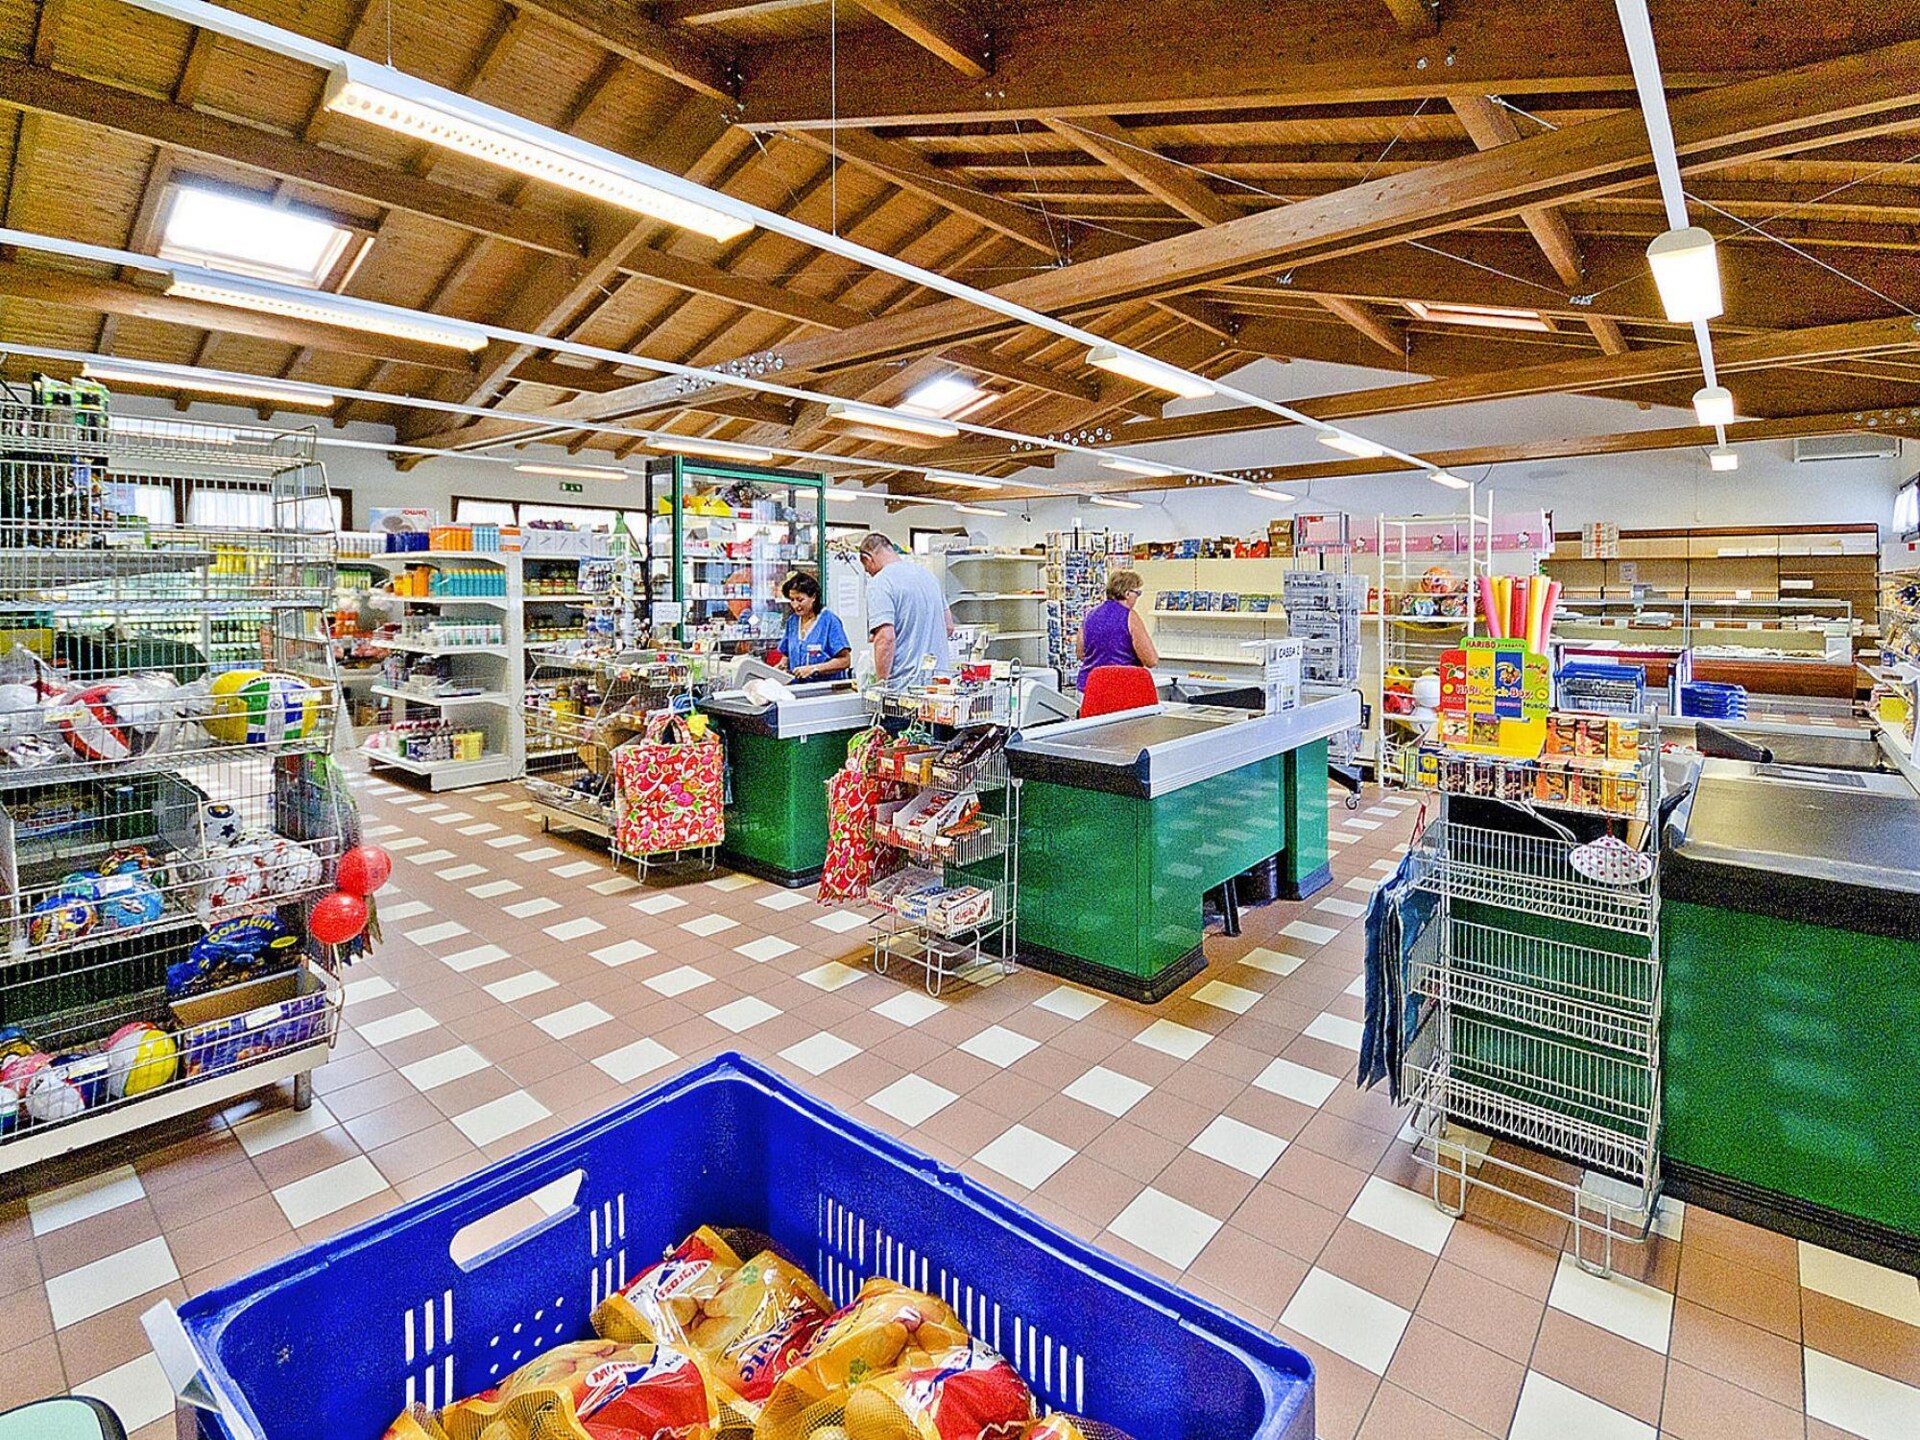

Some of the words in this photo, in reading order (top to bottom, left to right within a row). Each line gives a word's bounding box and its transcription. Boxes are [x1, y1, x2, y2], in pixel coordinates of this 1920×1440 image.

[1466, 640, 1496, 649] HARIBO
[1279, 647, 1296, 659] CASSA
[208, 918, 275, 944] DOLPHIN
